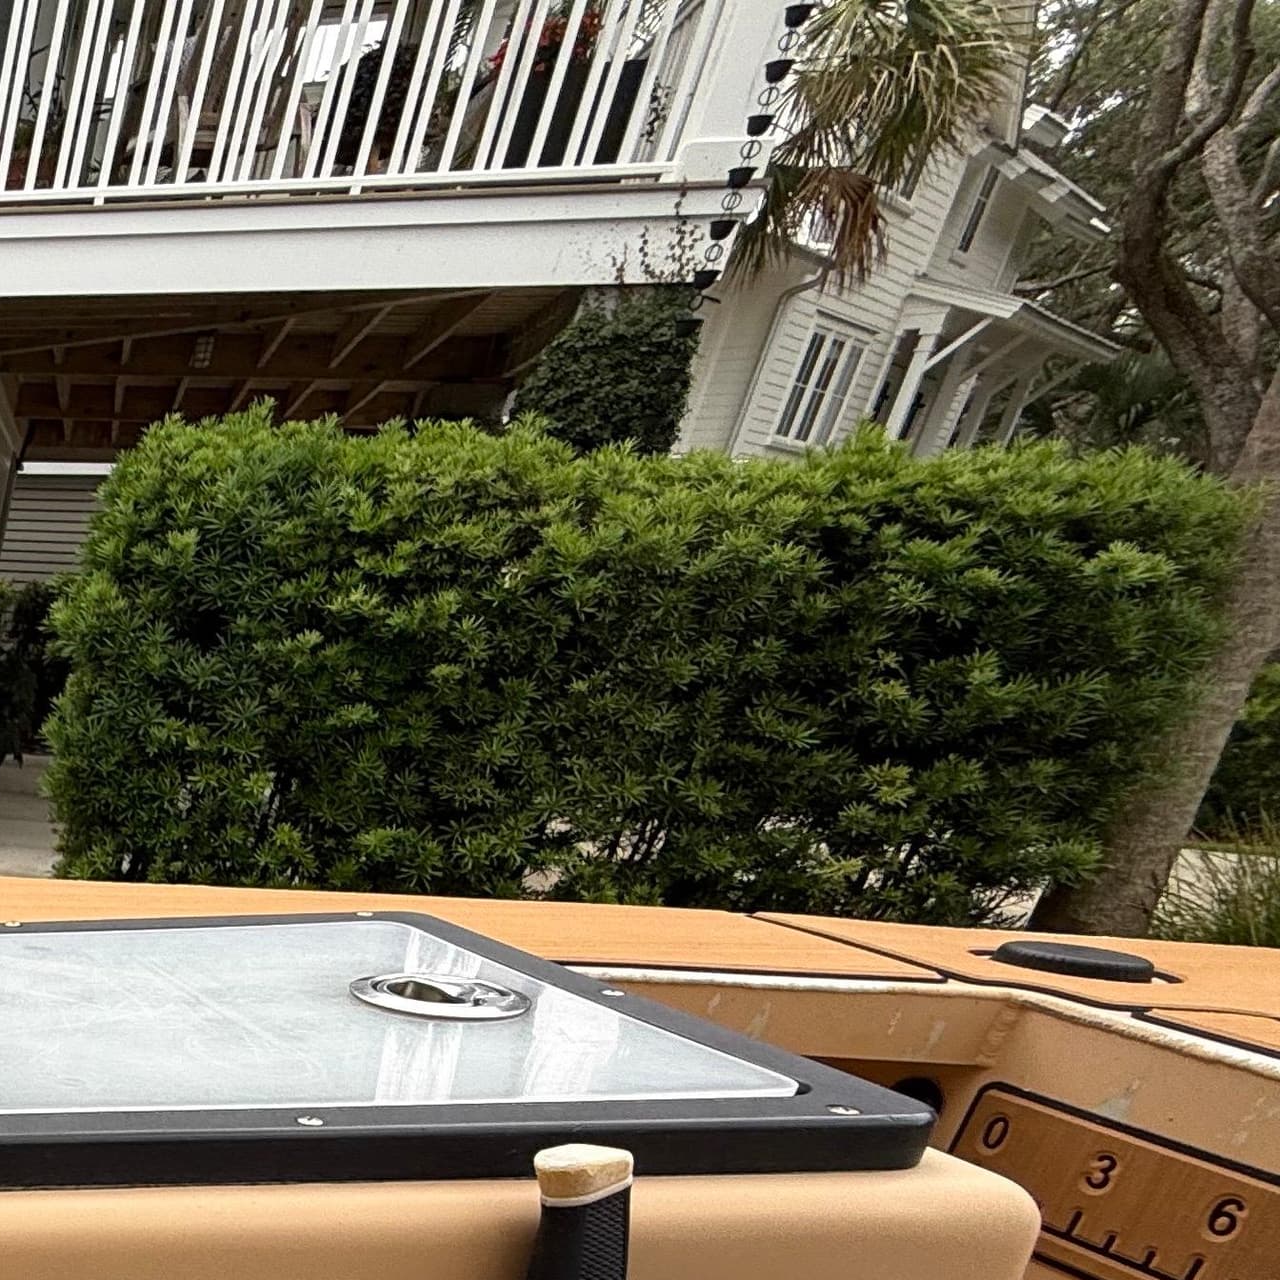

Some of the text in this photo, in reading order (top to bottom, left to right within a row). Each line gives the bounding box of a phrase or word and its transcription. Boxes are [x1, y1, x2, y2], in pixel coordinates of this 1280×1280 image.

[982, 1116, 1246, 1236] 0 3 6
